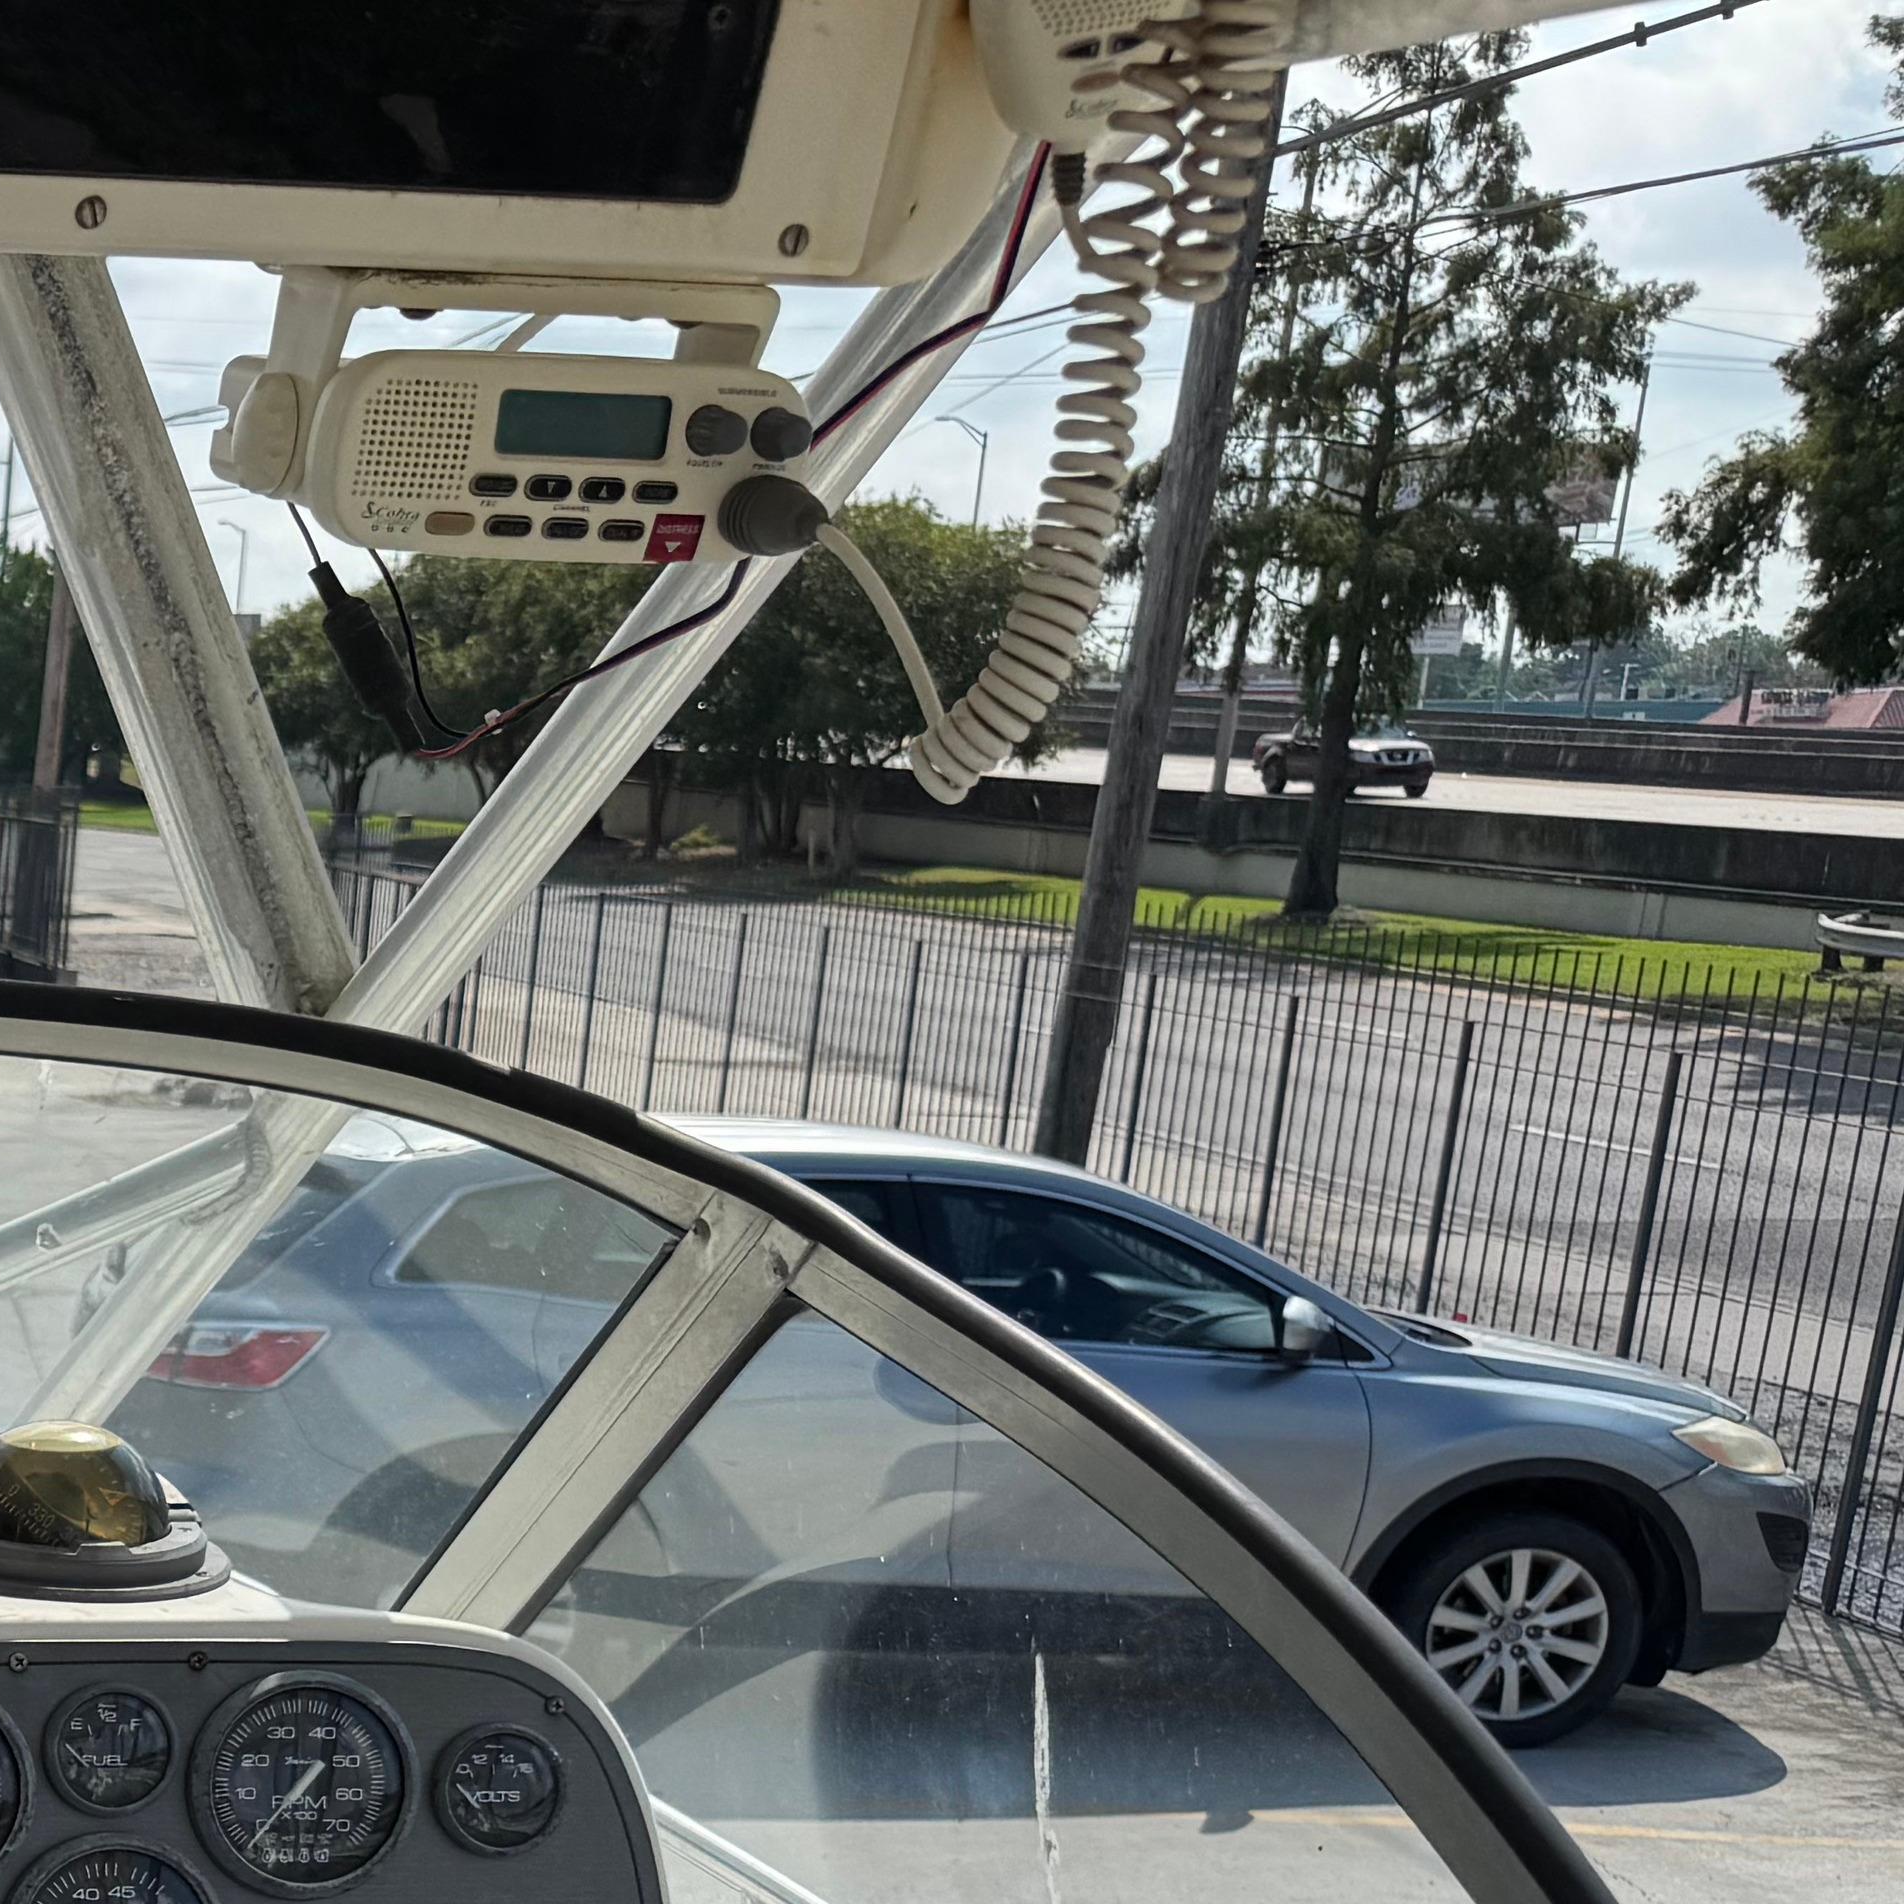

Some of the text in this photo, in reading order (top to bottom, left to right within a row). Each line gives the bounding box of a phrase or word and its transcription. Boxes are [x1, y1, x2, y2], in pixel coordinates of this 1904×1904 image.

[71, 1718, 142, 1730] E F
[267, 1726, 336, 1739] 30 40
[81, 1754, 129, 1767] FUEL
[241, 1755, 270, 1768] 20
[332, 1755, 360, 1768] 50
[234, 1787, 363, 1801] 10 60
[469, 1790, 521, 1803] VOLTS
[271, 1795, 327, 1809] RPM
[322, 1818, 350, 1832] 70
[72, 1885, 136, 1901] 40 45
